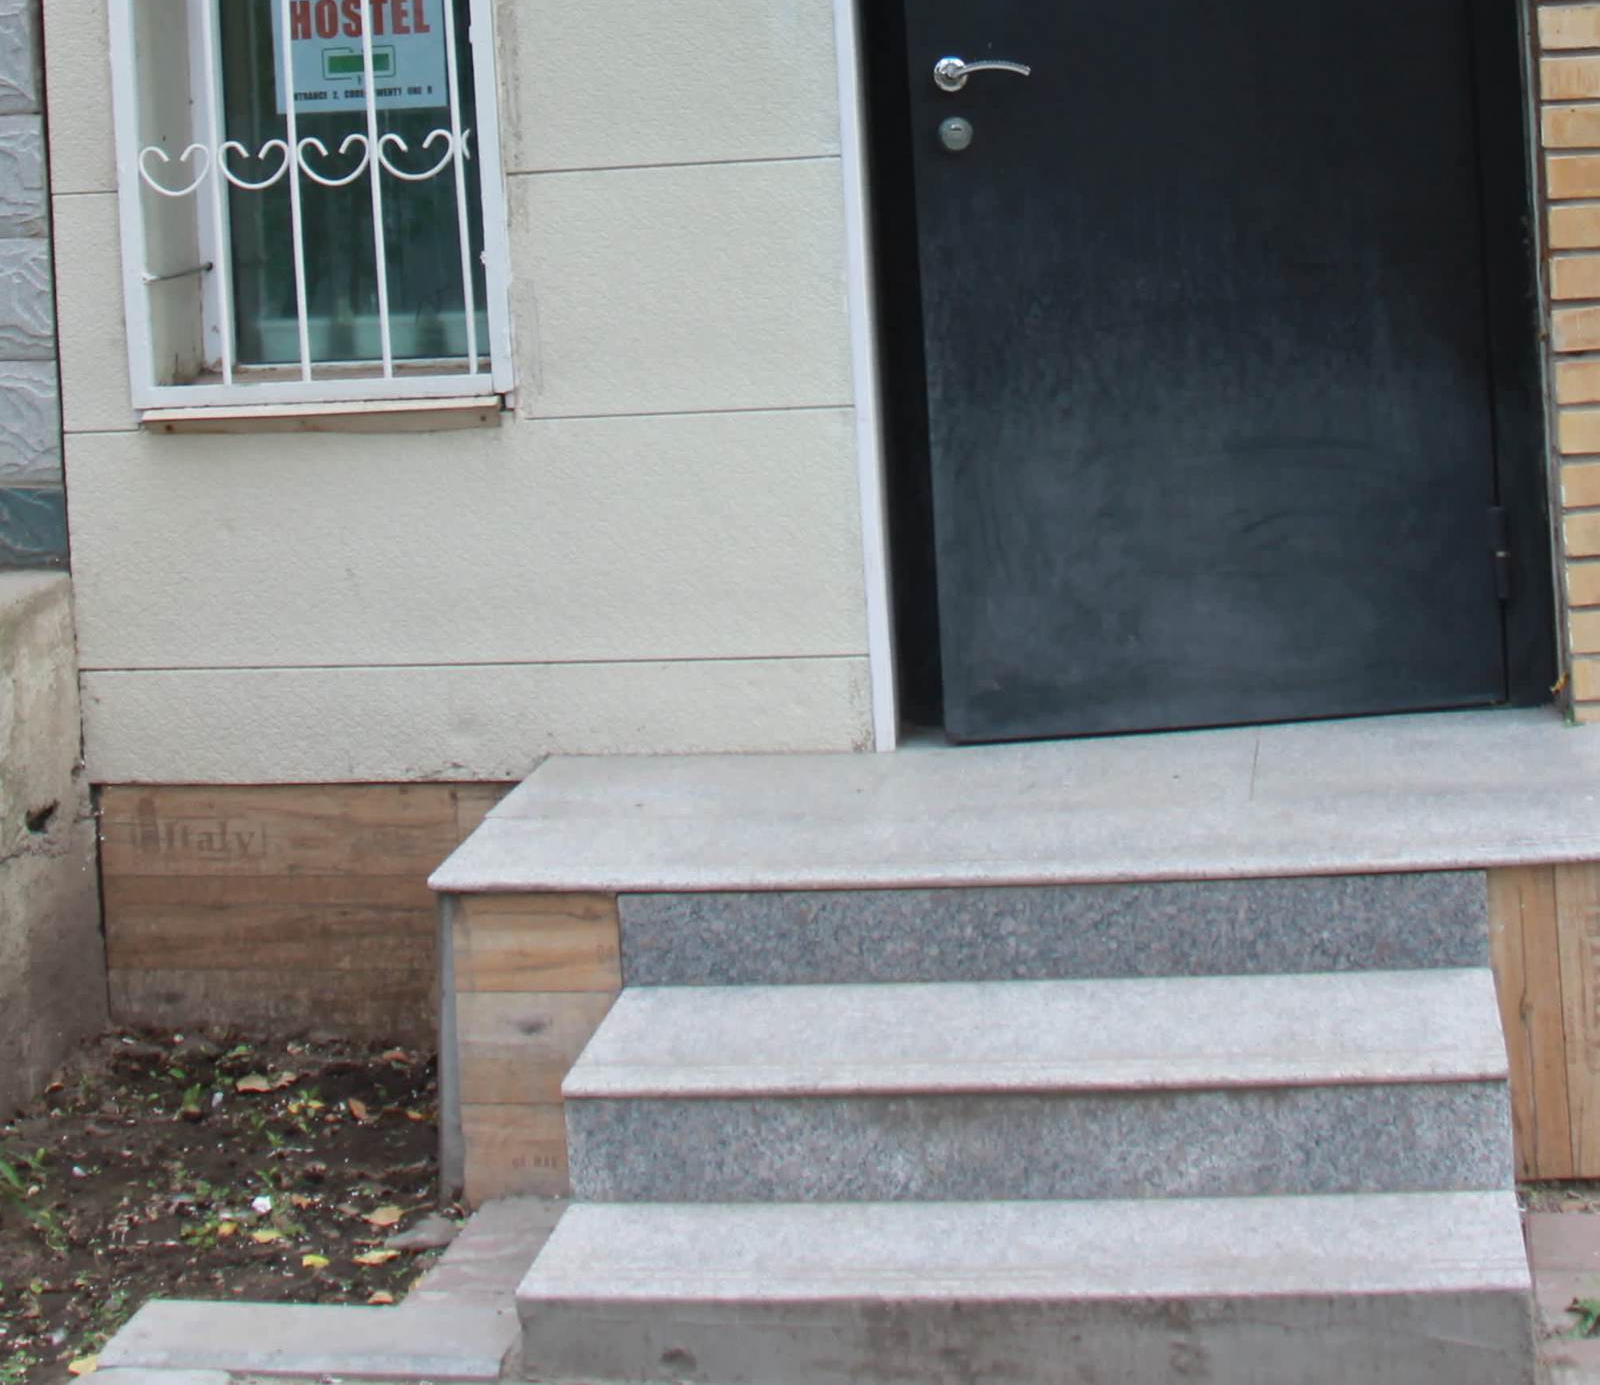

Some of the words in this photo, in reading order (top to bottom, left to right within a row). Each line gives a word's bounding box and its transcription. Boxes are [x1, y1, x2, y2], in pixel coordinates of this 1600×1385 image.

[294, 91, 327, 101] NTRANCE
[376, 87, 402, 96] WENTY
[164, 821, 256, 861] Italy
